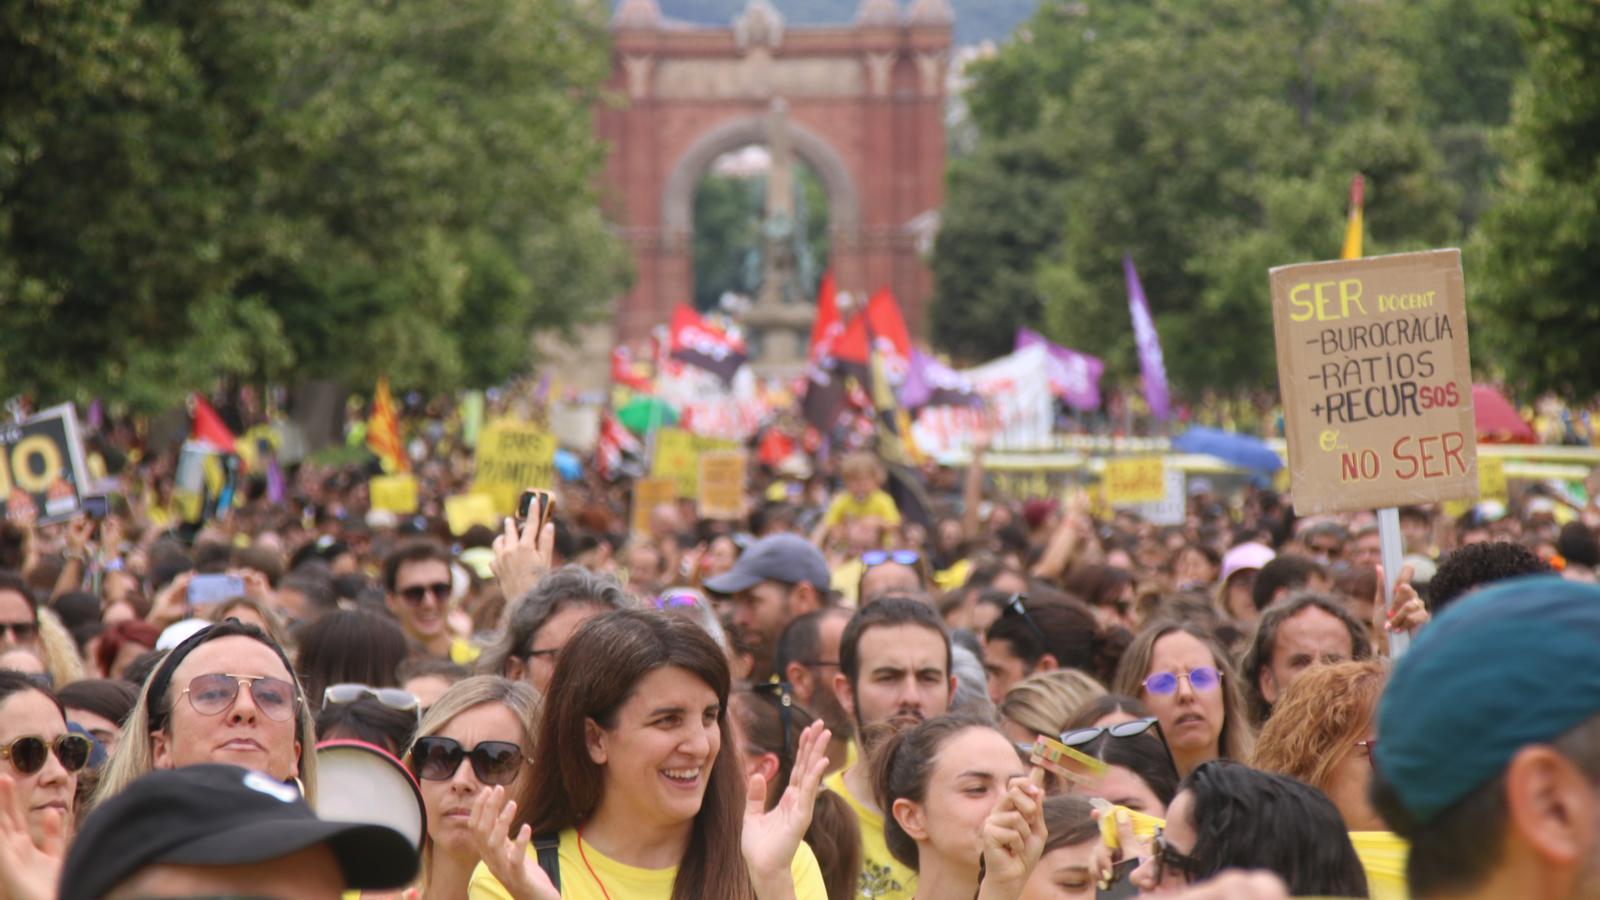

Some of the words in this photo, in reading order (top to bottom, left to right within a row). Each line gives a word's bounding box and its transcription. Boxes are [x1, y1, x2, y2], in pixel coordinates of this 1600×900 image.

[1289, 278, 1368, 322] SER
[1378, 291, 1436, 314] DOCENT
[1341, 449, 1381, 481] NO
[1391, 431, 1467, 481] SER
